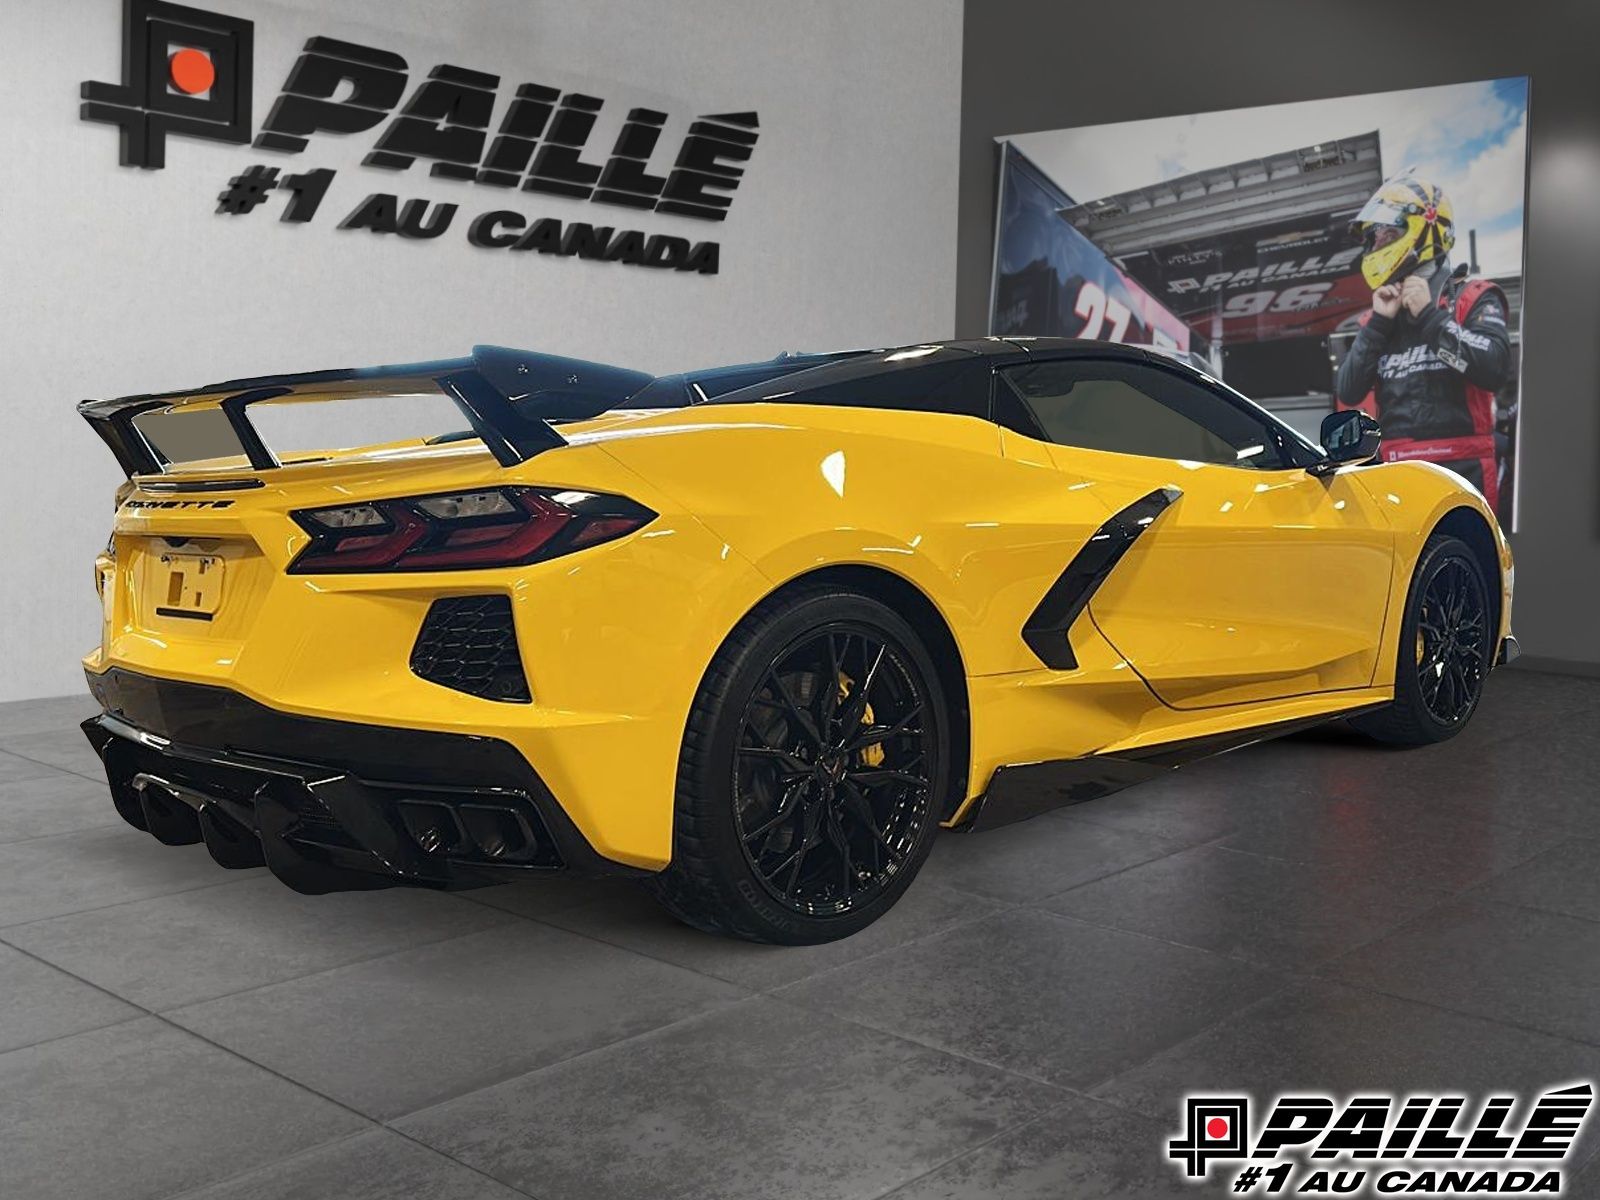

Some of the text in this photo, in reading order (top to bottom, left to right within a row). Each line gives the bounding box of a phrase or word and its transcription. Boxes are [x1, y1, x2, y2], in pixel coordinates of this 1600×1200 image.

[251, 36, 759, 222] PAILLÉ
[215, 165, 720, 275] #1 AU CANADA
[1222, 282, 1335, 318] 96
